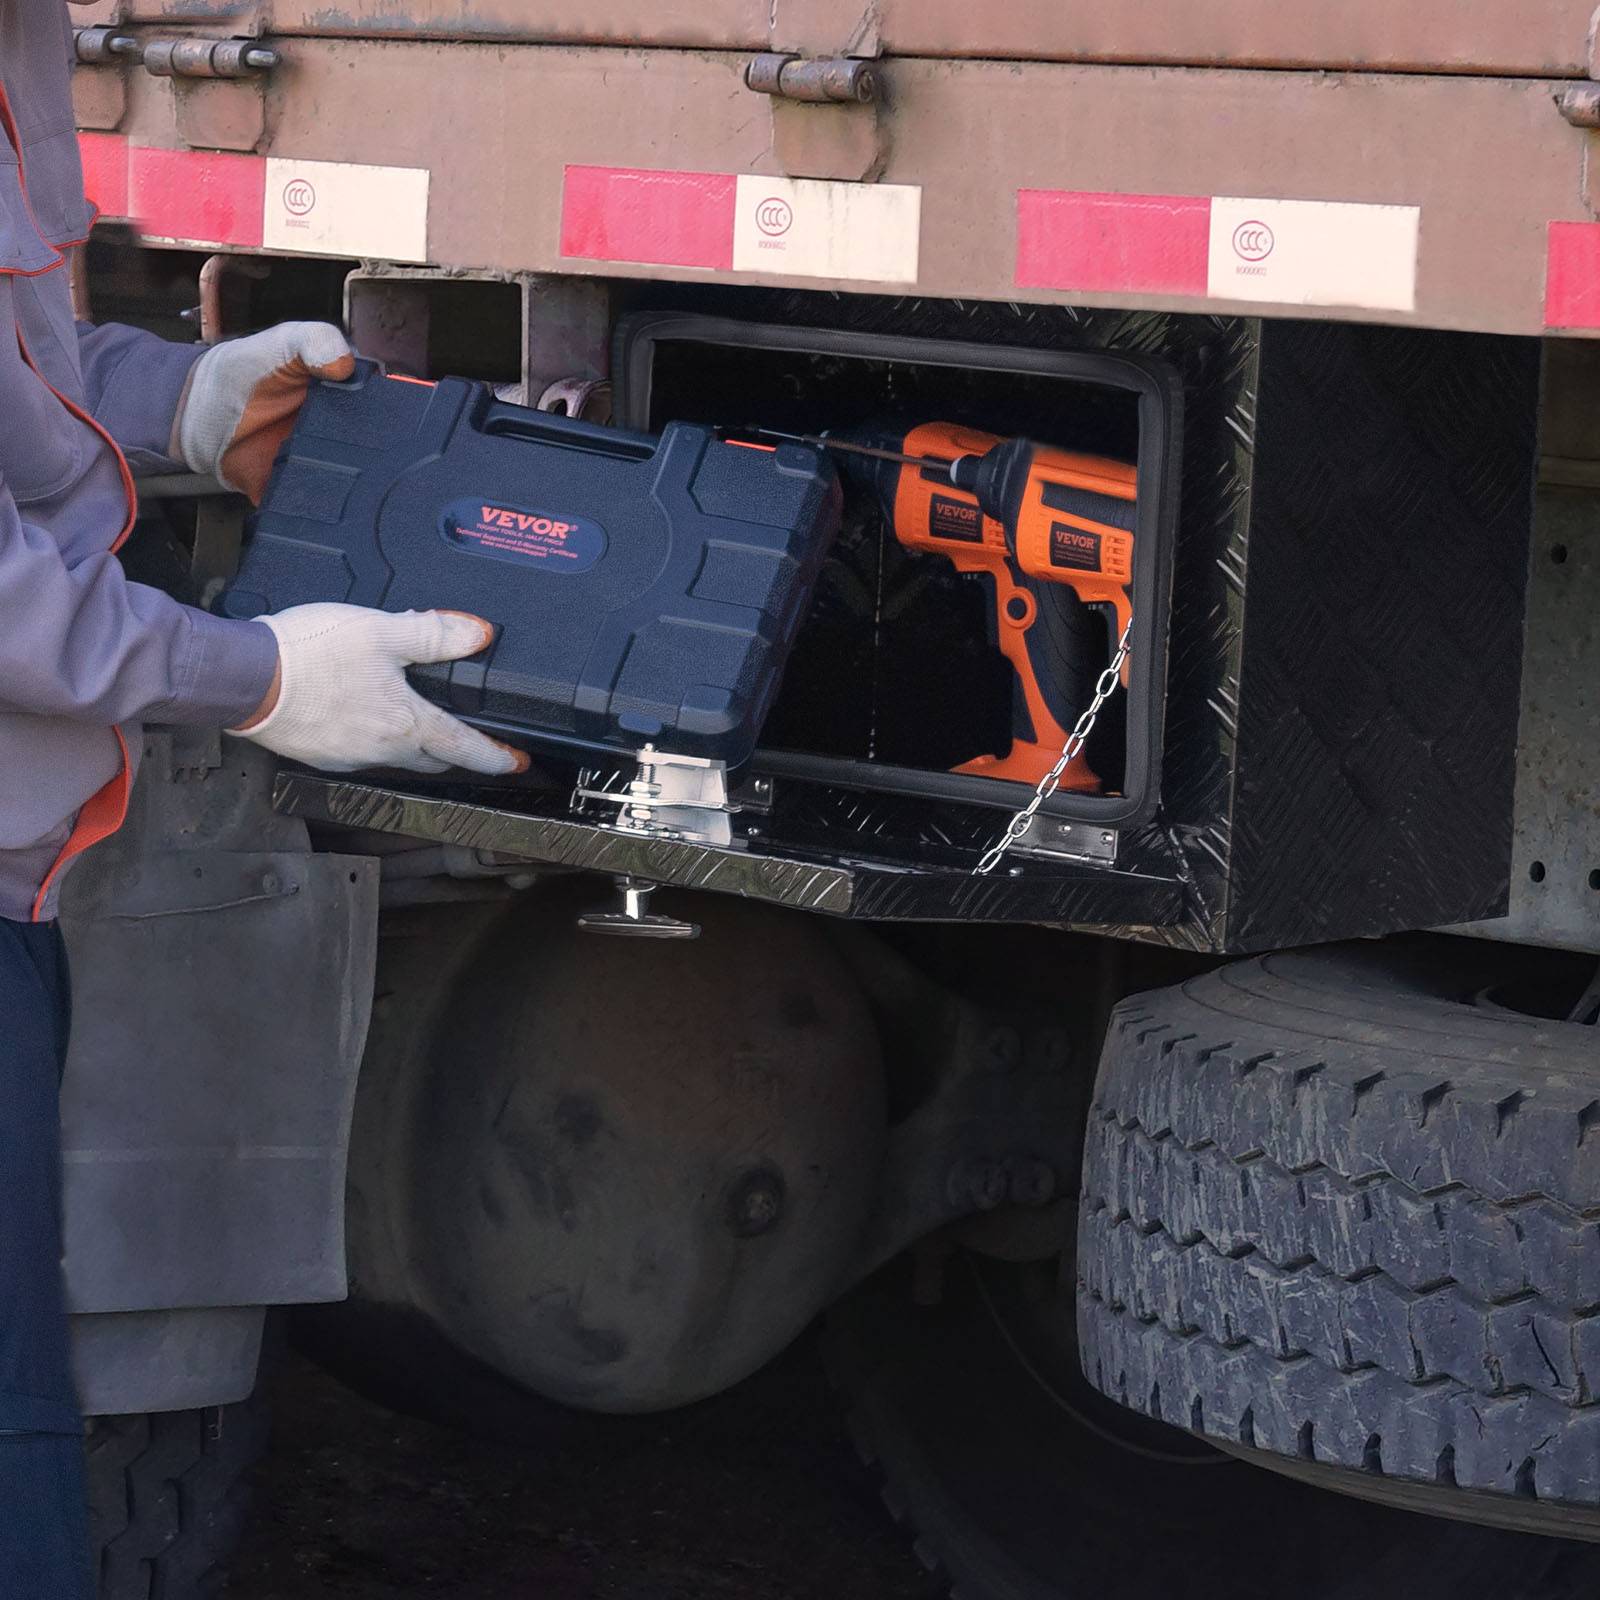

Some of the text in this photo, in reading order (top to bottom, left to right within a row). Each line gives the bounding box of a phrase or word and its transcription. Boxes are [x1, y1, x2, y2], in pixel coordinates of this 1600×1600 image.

[935, 502, 978, 521] VEVOR
[481, 506, 570, 539] VEVOR
[1055, 530, 1095, 550] VEVOR
